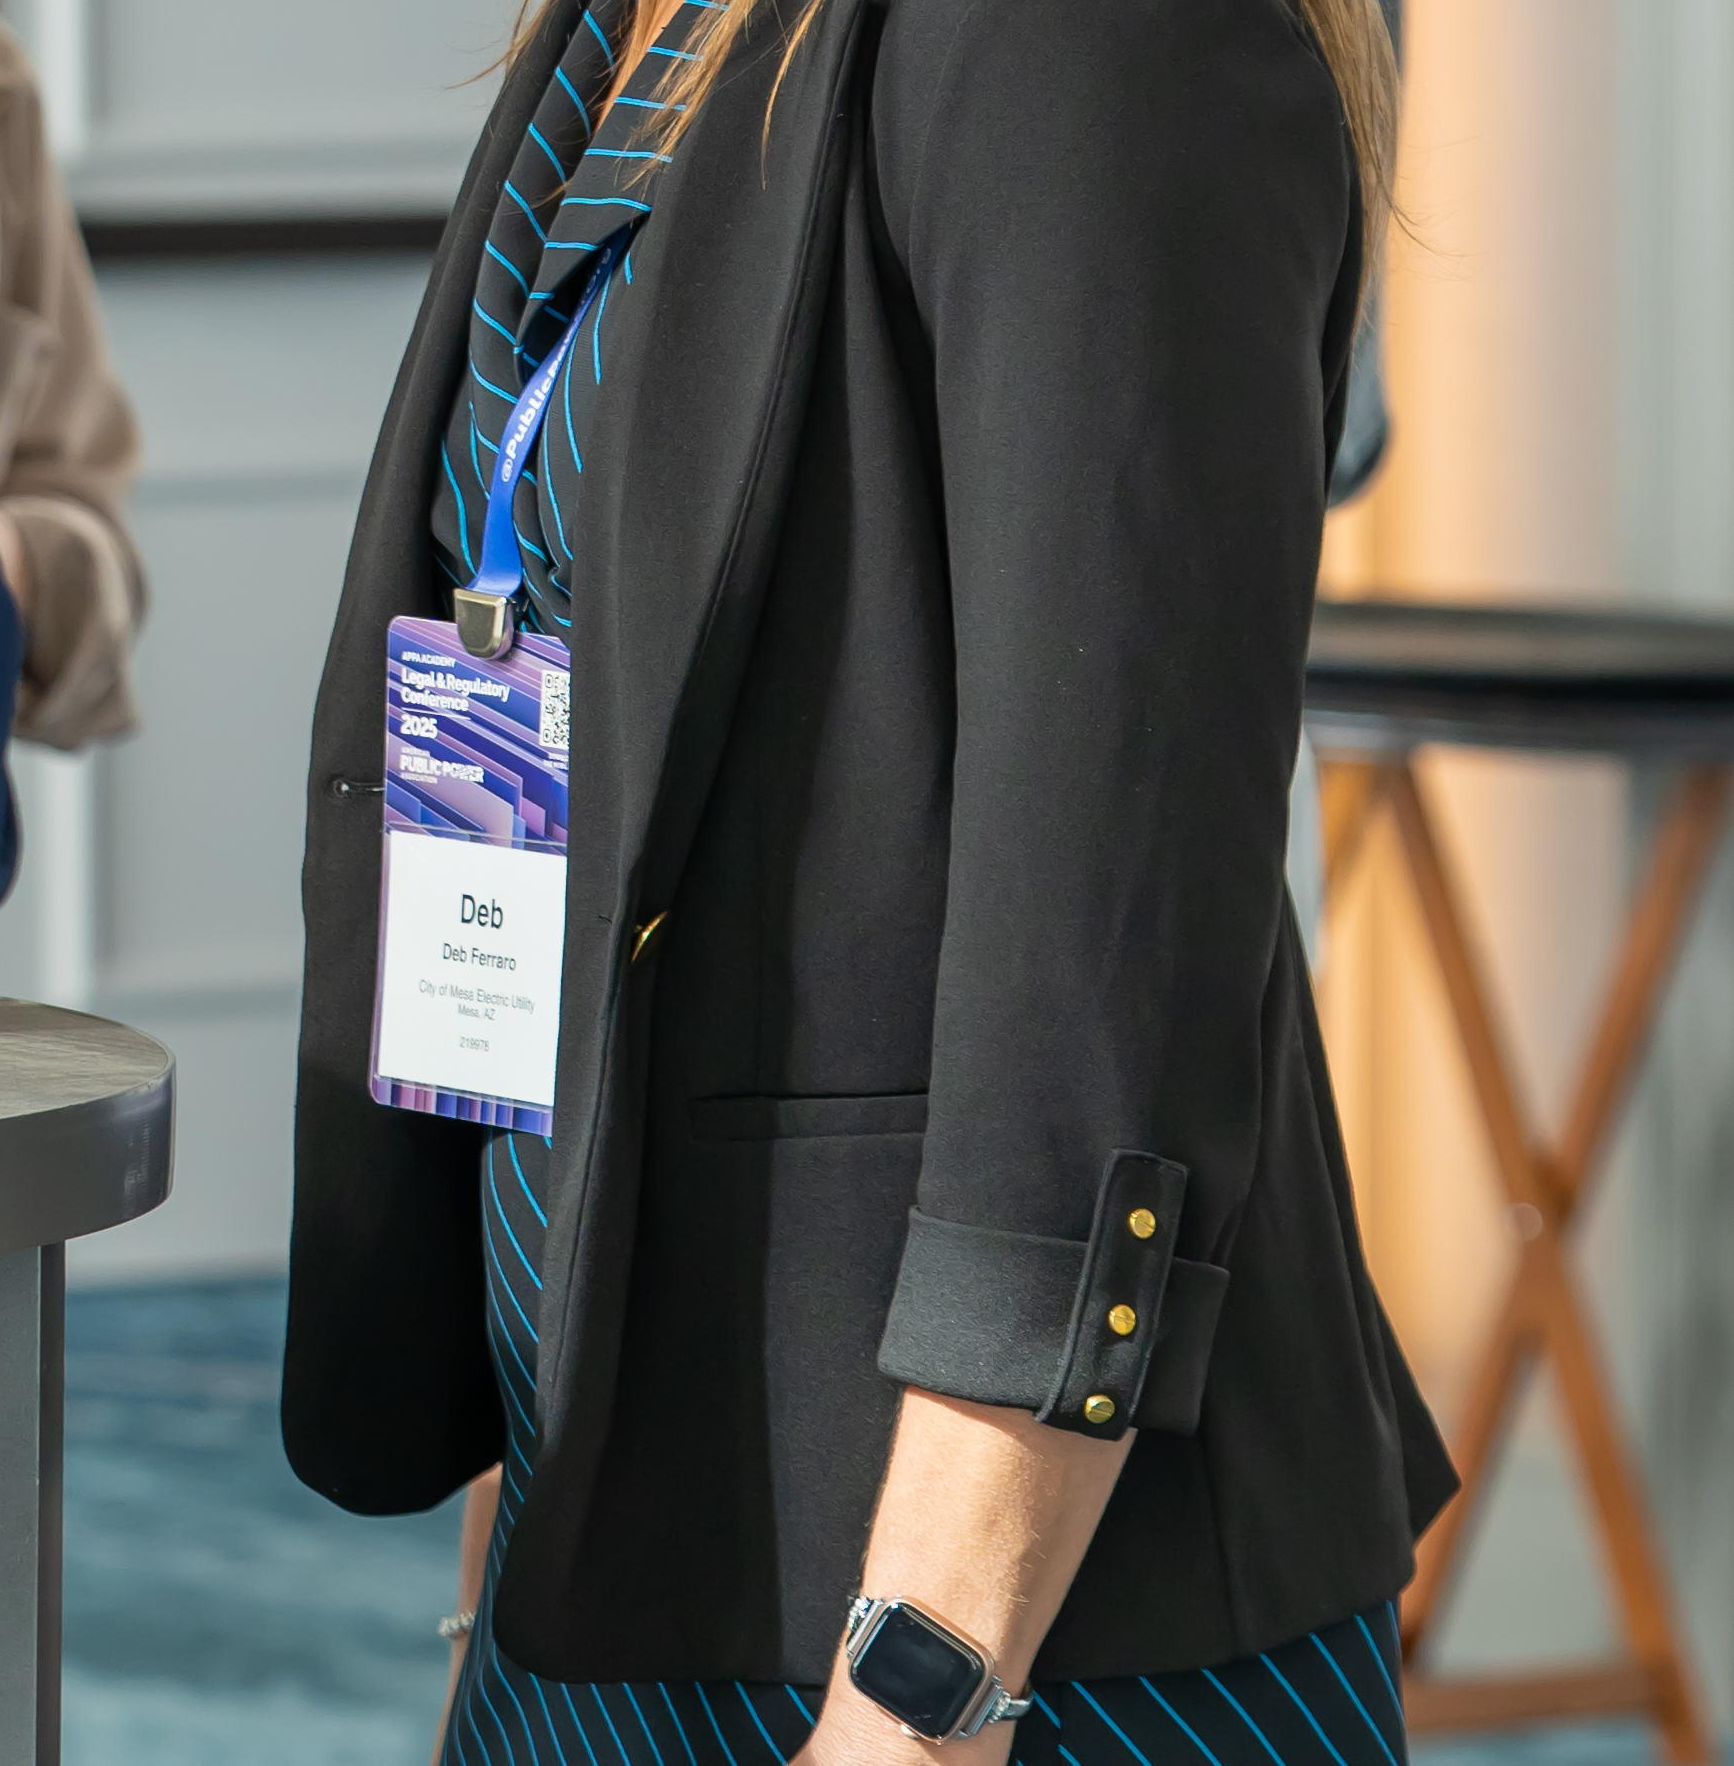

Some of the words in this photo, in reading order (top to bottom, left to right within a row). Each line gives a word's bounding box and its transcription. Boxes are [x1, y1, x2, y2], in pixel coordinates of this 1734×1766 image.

[400, 687, 469, 712] Conference
[401, 667, 436, 690] Legal
[436, 672, 446, 689] &
[446, 672, 511, 703] Regulatory
[400, 714, 438, 739] 2025
[400, 754, 442, 775] PUBLIC
[442, 760, 485, 783] POWER
[460, 892, 505, 929] Deb
[443, 942, 467, 963] Deb
[471, 946, 517, 971] Ferraro
[419, 978, 437, 998] City
[439, 983, 448, 996] of
[450, 984, 474, 1002] Mesa
[476, 988, 510, 1007] Electric
[511, 993, 536, 1014] Utility
[458, 1003, 481, 1019] Mesa,
[484, 1007, 496, 1021] AZ
